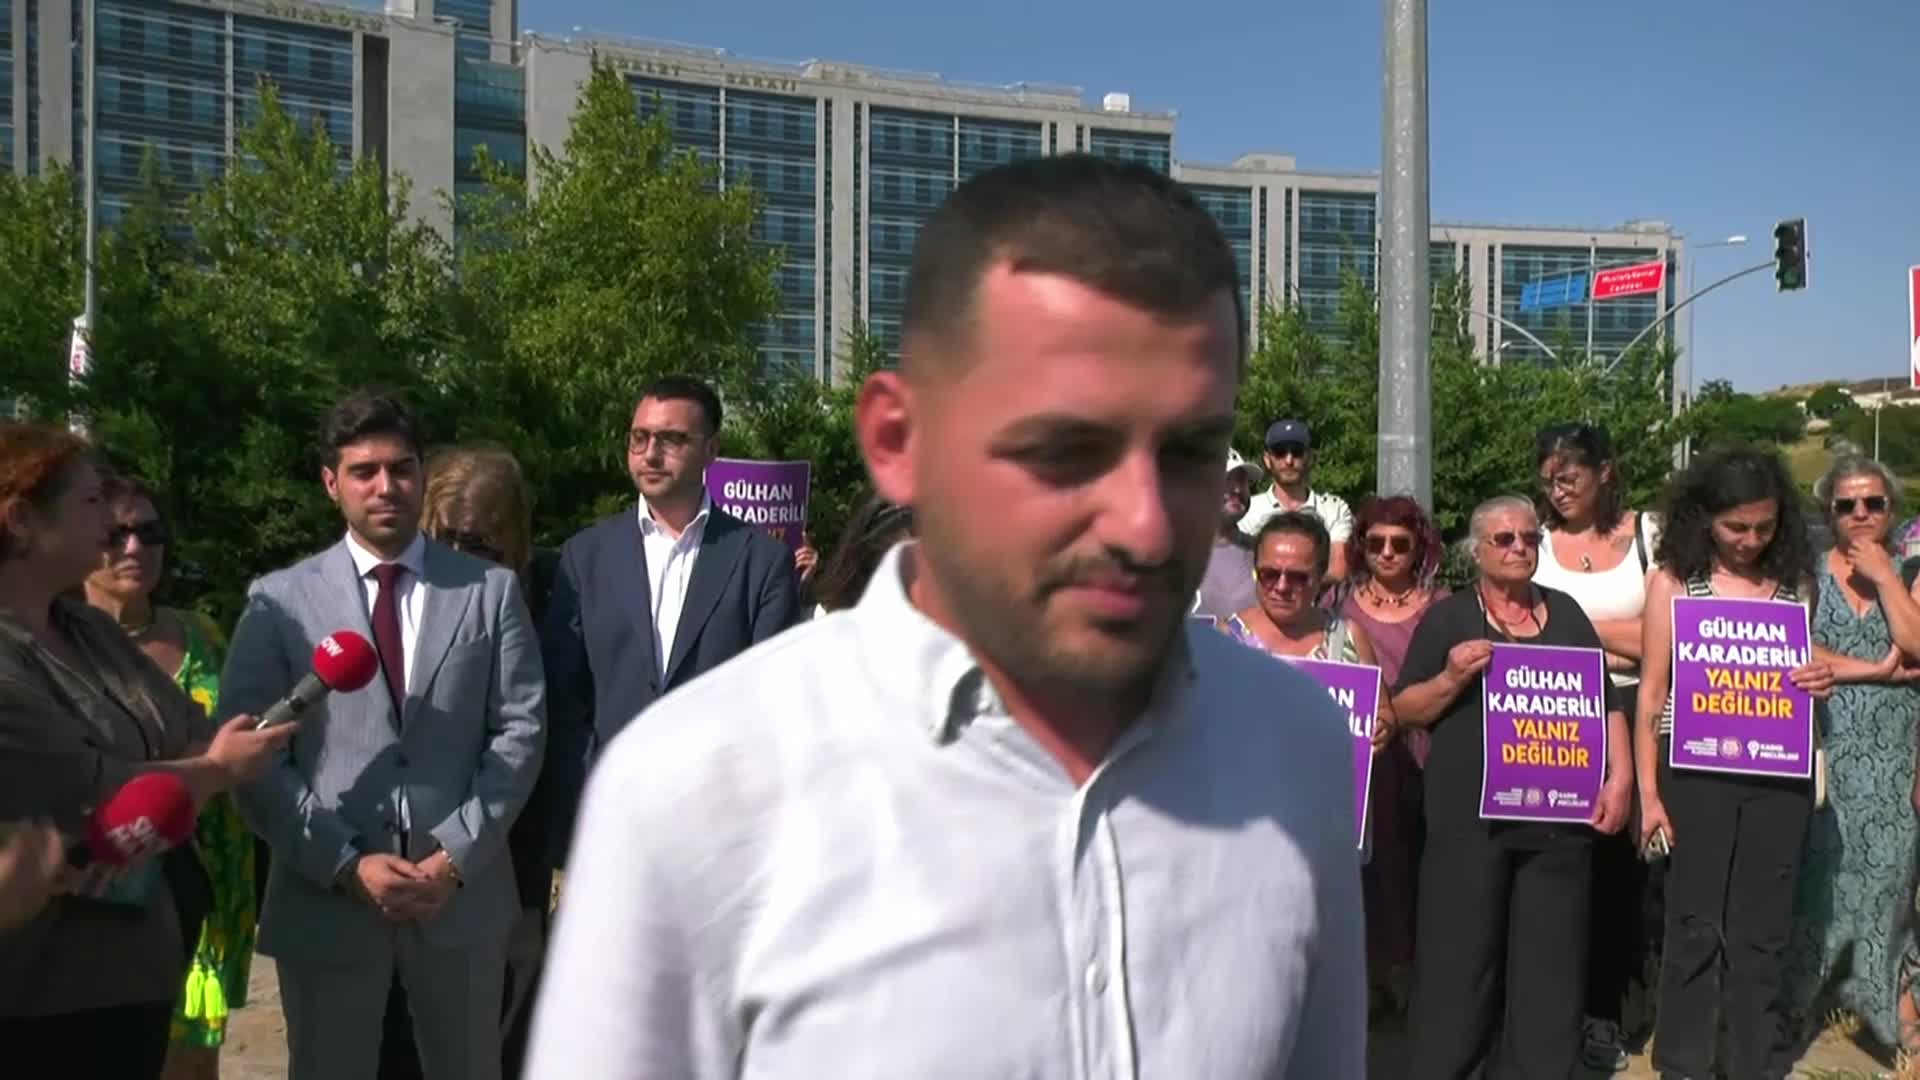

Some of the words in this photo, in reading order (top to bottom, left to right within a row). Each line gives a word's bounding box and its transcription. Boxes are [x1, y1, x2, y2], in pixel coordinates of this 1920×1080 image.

[723, 478, 794, 501] GÜLHAN
[722, 502, 804, 523] ARADERİLİ
[1698, 616, 1787, 643] GÜLHAN
[1678, 642, 1807, 667] KARADERİLİ
[1505, 665, 1582, 692] GÜLHAN
[1705, 667, 1782, 692] YALNIZ
[1488, 692, 1601, 718] KARADERİLİ
[1692, 690, 1794, 719] DEĞİLDİR
[1512, 718, 1581, 743] YALNIZ
[1502, 740, 1590, 768] DEĞİLDİR
